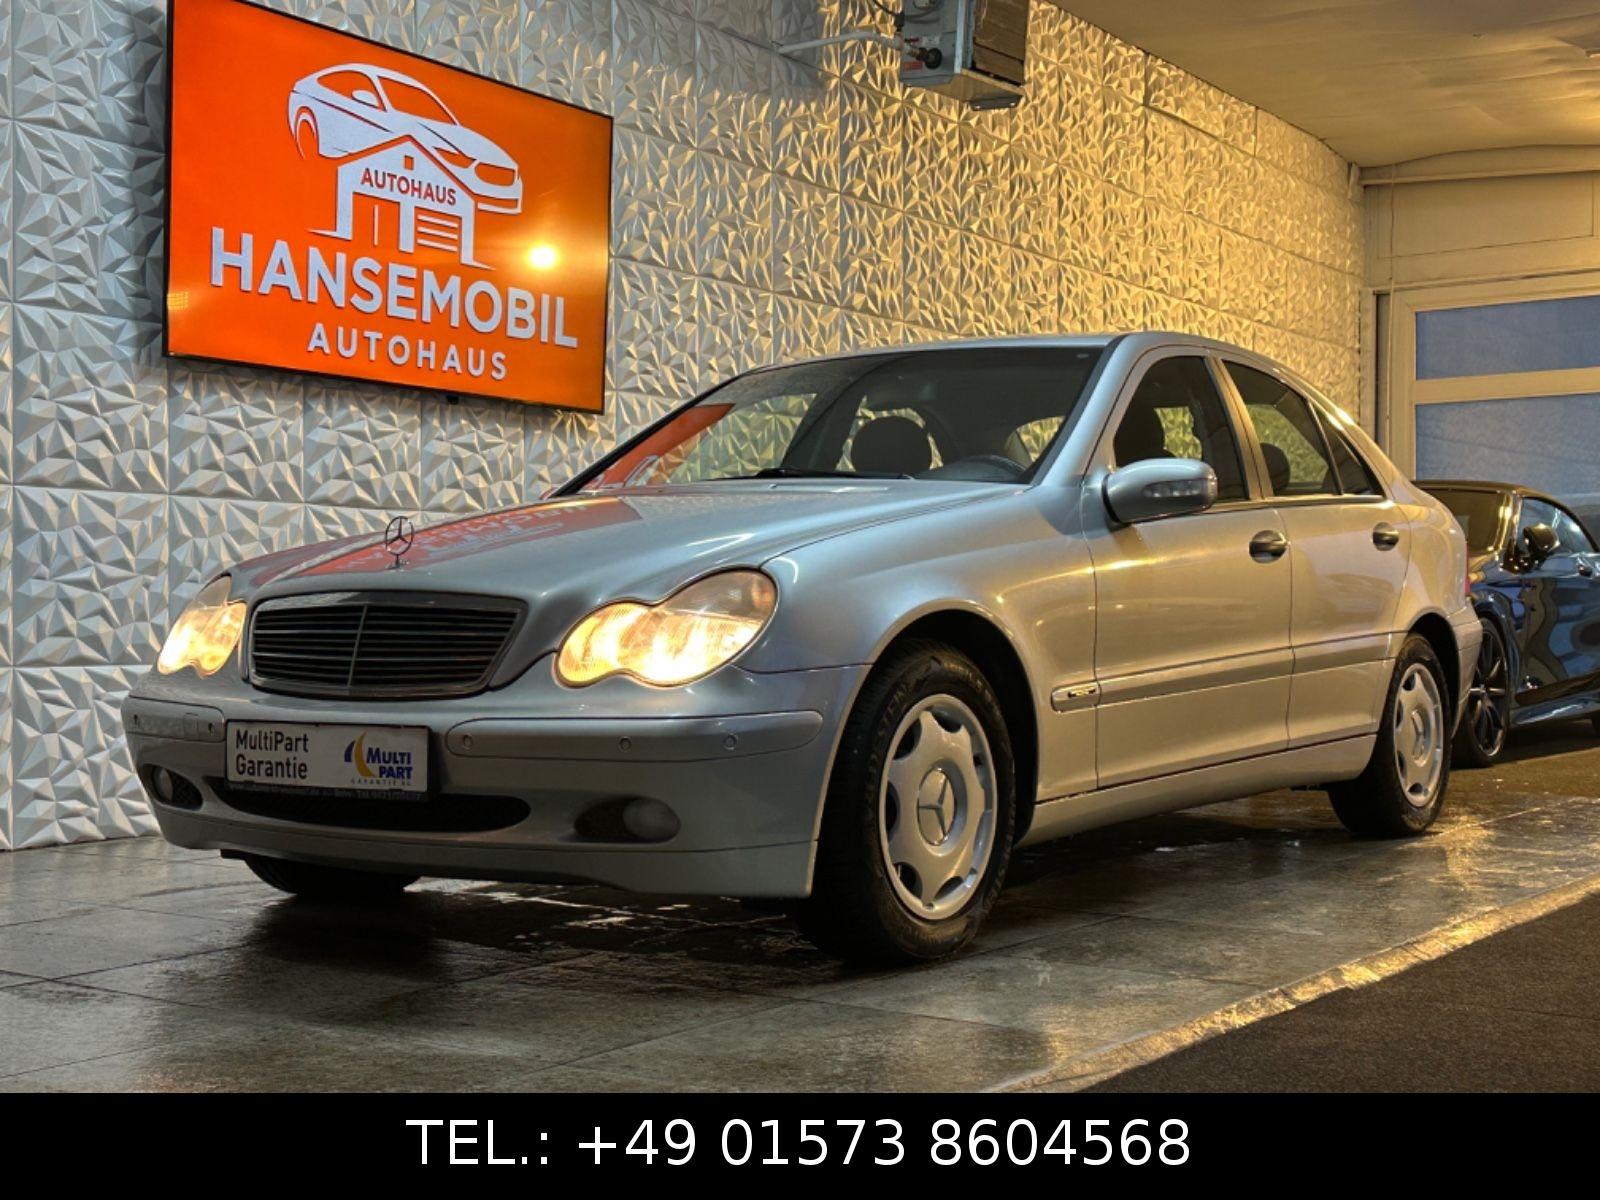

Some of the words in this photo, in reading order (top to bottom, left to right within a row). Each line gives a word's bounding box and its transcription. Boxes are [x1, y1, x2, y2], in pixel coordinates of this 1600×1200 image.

[361, 168, 457, 206] AUTOHAUS
[210, 227, 578, 348] HANSEMOBIL
[307, 323, 507, 380] AUTOHAUS
[236, 729, 309, 753] MultiPart
[236, 754, 308, 779] Garantie
[379, 766, 413, 780] PART
